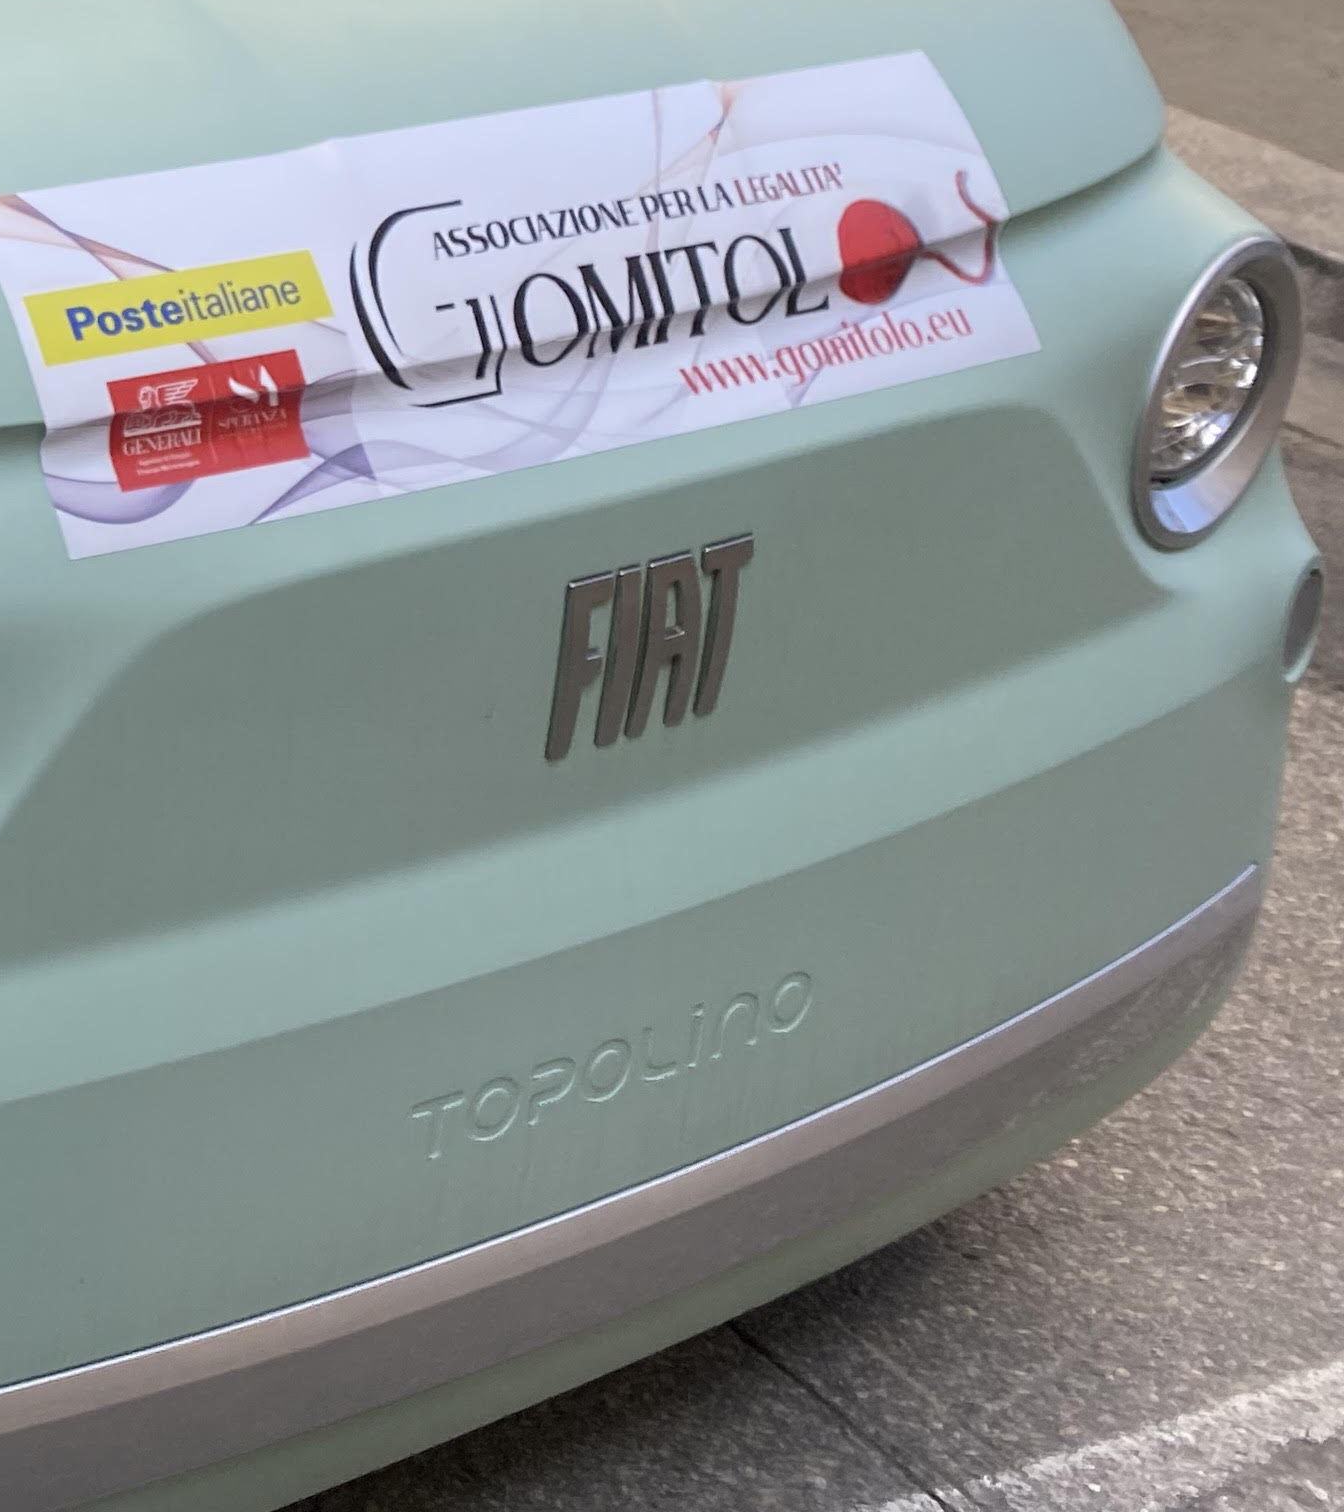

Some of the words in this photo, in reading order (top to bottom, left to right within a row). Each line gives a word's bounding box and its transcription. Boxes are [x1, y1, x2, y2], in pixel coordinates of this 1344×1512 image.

[432, 197, 635, 261] ASSOCIAZIONE
[638, 188, 696, 226] PER
[696, 183, 735, 213] LA
[65, 279, 302, 342] Posteitaliane
[678, 307, 975, 397] www.gomitolo.eu
[122, 428, 203, 457] GENERALI
[544, 530, 756, 763] FIAT
